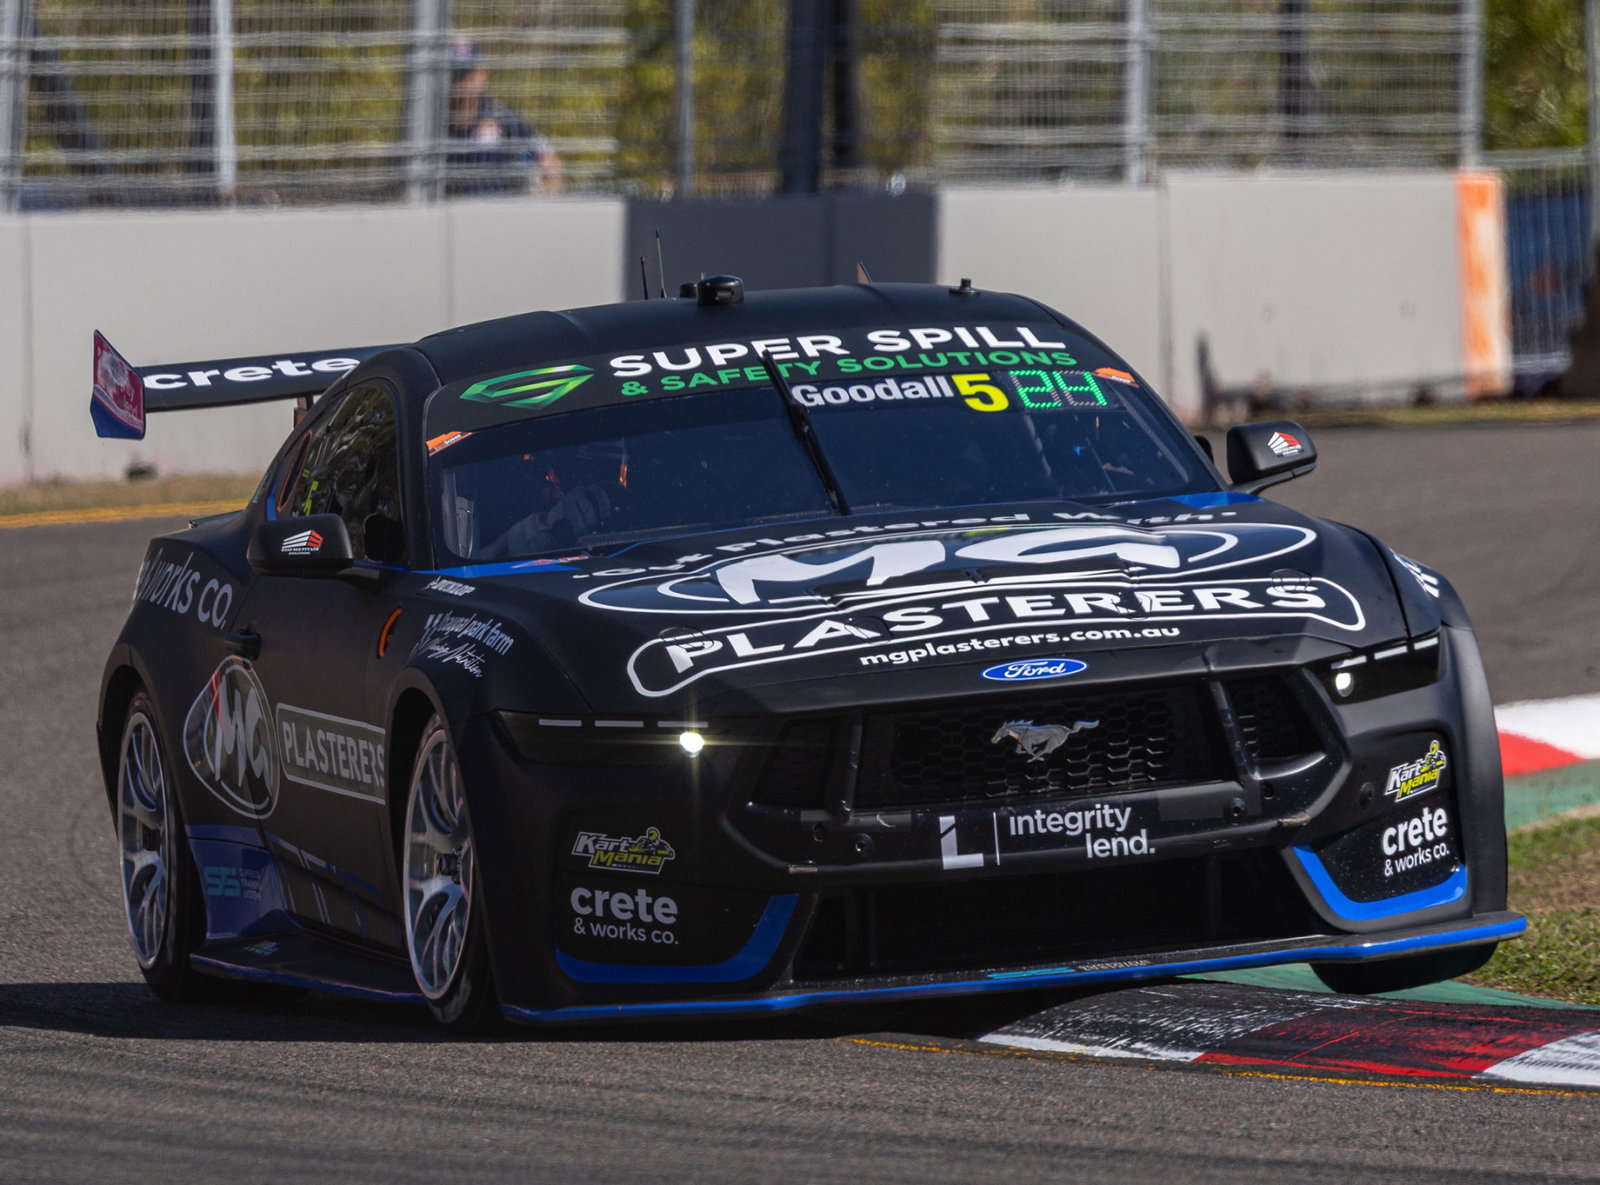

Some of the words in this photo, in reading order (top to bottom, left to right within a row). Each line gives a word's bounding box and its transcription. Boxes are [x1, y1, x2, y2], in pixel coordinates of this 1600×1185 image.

[609, 334, 851, 377] SUPER
[867, 326, 1066, 351] SPILL
[143, 357, 361, 389] crete
[621, 380, 649, 396] &
[660, 361, 821, 390] SAFETY
[837, 351, 1078, 374] SOLUTIONS
[792, 375, 954, 407] Goodall
[951, 373, 1009, 412] 5
[198, 578, 233, 631] co.
[482, 622, 514, 656] farm
[665, 585, 1326, 674] PLASTERERS
[860, 627, 1181, 666] mgplasterers.com.au
[282, 721, 386, 788] PLASTERERS
[1388, 766, 1422, 791] Kart
[1398, 768, 1440, 799] Mania
[1009, 803, 1133, 836] integrity
[1382, 806, 1448, 856] crete
[575, 834, 630, 854] Kart
[592, 850, 662, 866] Mania
[1085, 828, 1156, 859] lend.
[1384, 858, 1394, 877] &
[1395, 846, 1432, 873] works
[1433, 842, 1450, 859] co.
[570, 887, 678, 925] crete
[573, 917, 586, 935] &
[590, 922, 647, 942] works
[651, 929, 679, 945] co.
